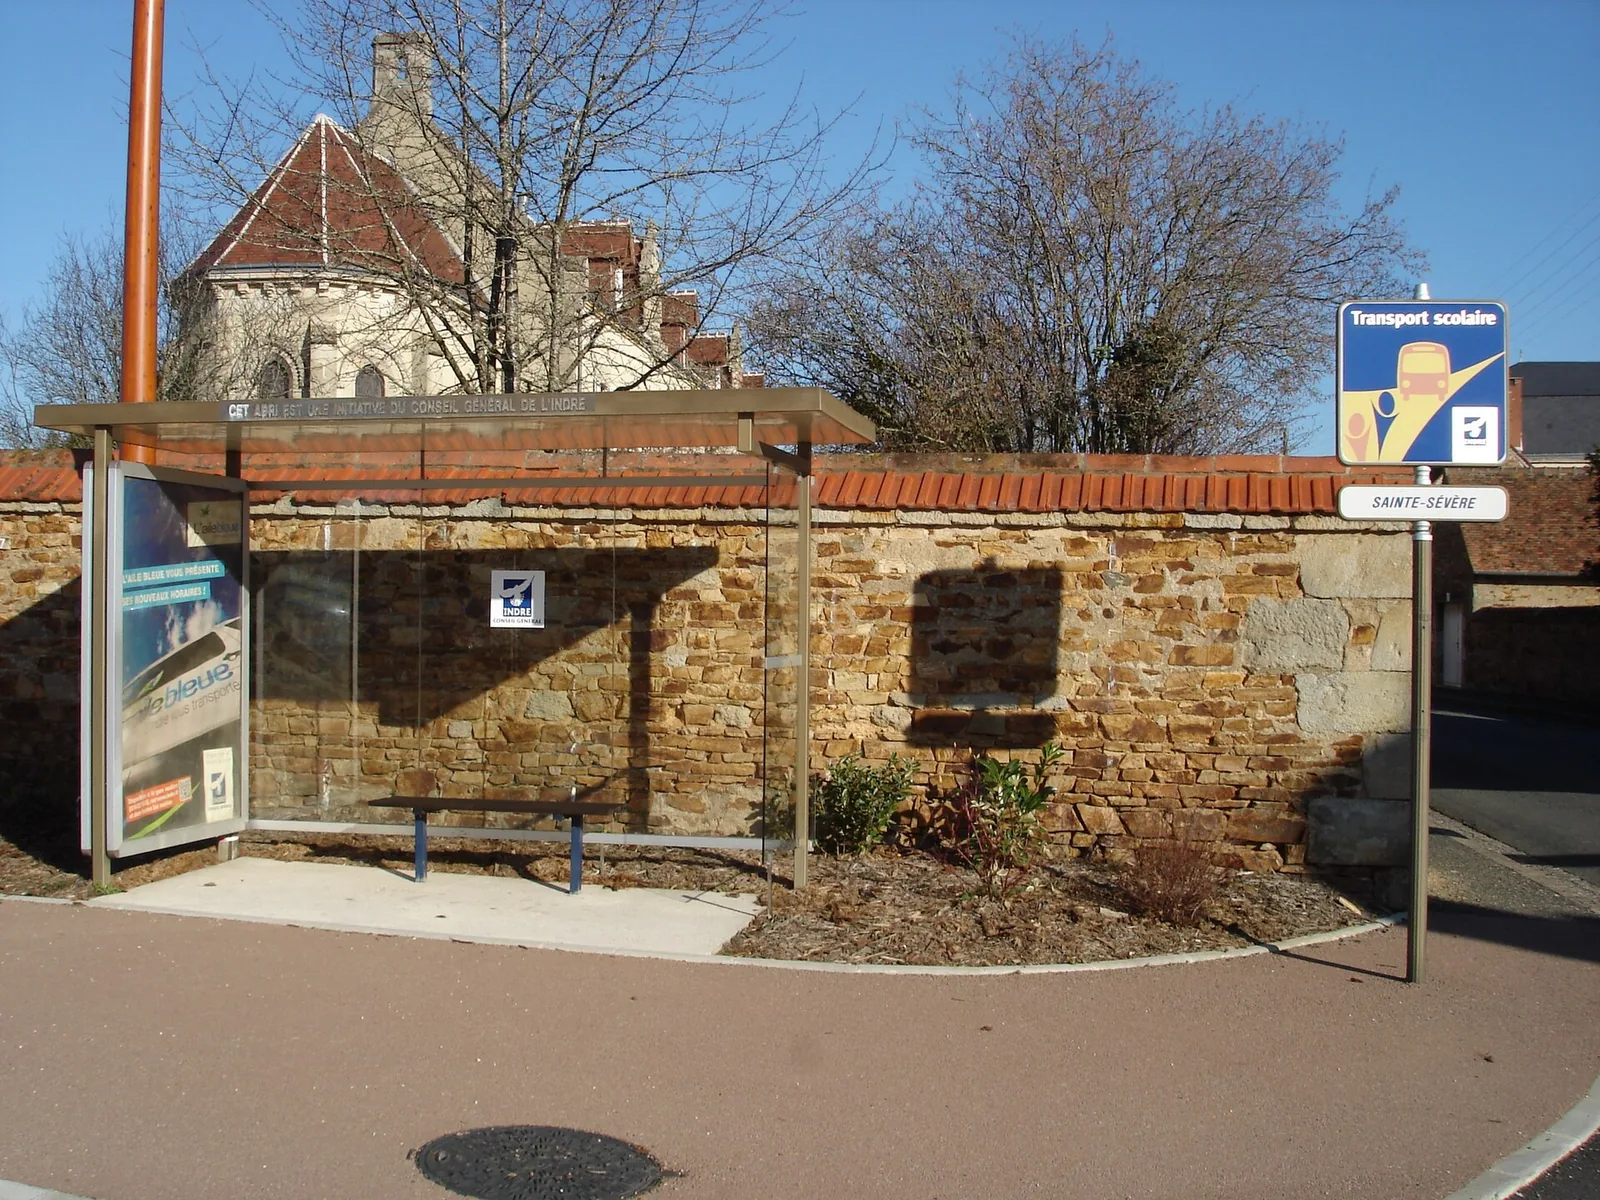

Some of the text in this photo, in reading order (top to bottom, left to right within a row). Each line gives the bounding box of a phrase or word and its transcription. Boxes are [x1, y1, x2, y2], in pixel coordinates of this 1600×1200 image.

[1351, 310, 1497, 329] Transport scolaire
[229, 403, 249, 418] CET
[254, 403, 279, 418] ABRI
[335, 401, 386, 416] INITIATIVE
[391, 401, 406, 414] DU
[411, 400, 459, 414] CONSEIL
[521, 399, 536, 411] DE
[541, 397, 586, 411] L'INDRE
[1372, 495, 1477, 509] SAINTE-SÉVÈRE
[143, 570, 165, 580] BLEUE
[166, 567, 184, 578] VOUS
[185, 564, 220, 576] PRÉSENTE
[134, 592, 169, 605] NOUVEAUX
[170, 587, 202, 599] HORAIRES
[503, 607, 532, 616] INDRE
[191, 681, 242, 710] transporte
